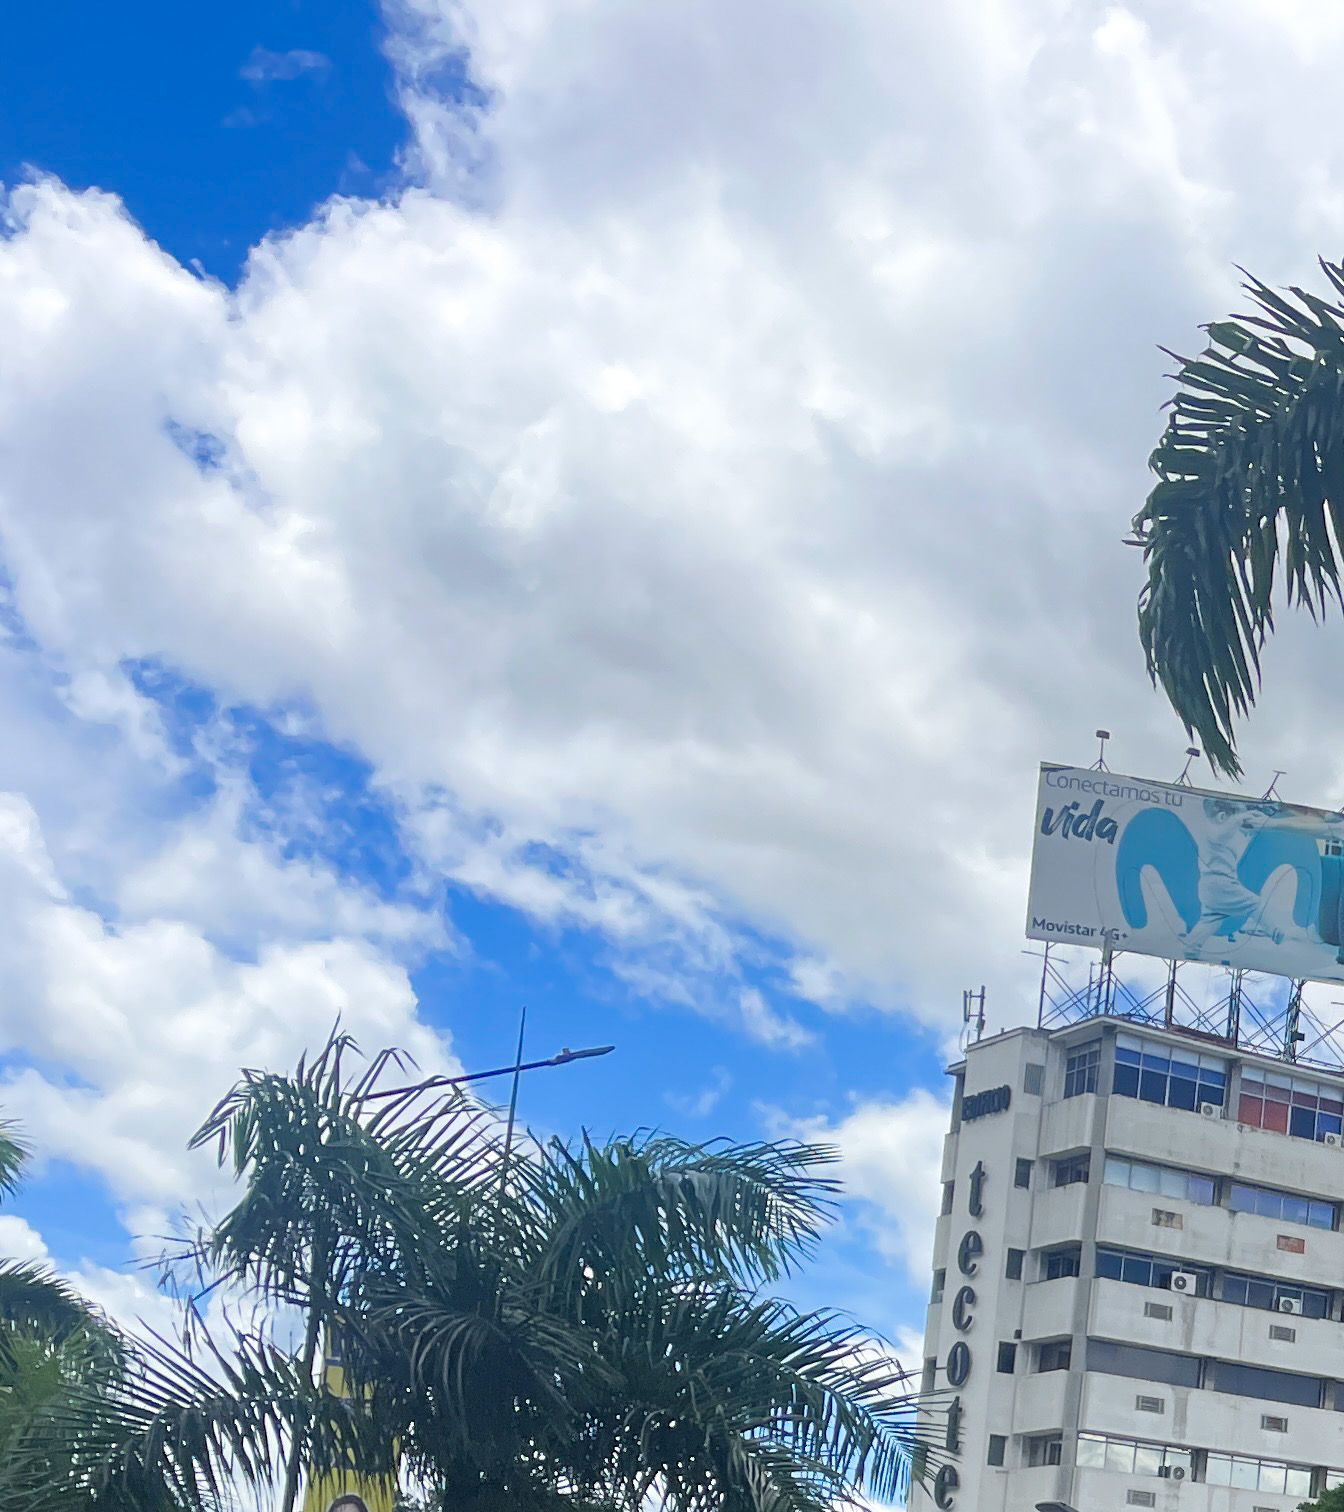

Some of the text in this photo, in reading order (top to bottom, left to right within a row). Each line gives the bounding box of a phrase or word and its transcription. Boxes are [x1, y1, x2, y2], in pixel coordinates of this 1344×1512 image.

[1045, 769, 1183, 807] Conectamos tu
[1041, 799, 1117, 845] vida
[1032, 917, 1097, 938] Movistar
